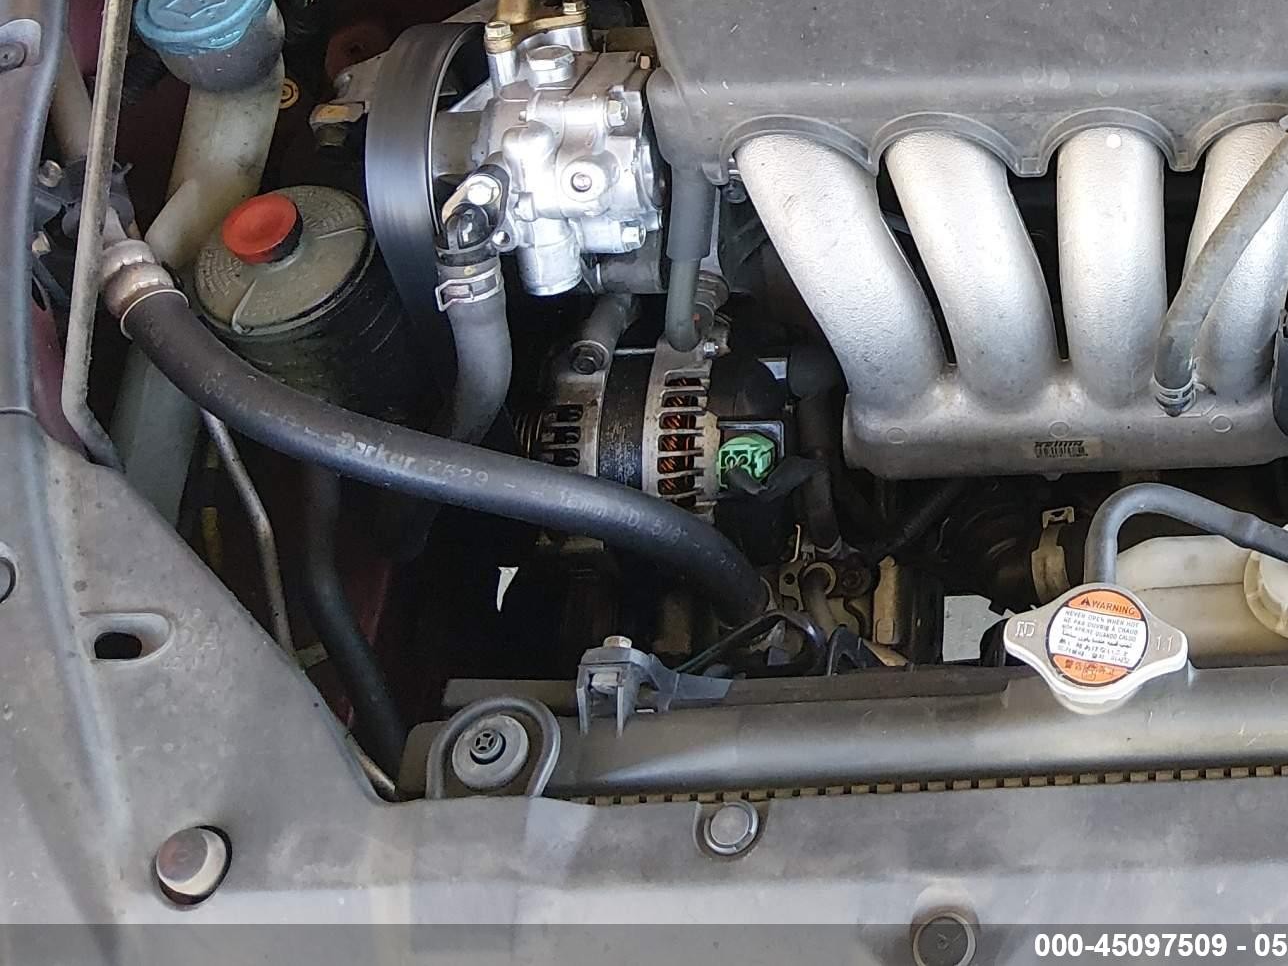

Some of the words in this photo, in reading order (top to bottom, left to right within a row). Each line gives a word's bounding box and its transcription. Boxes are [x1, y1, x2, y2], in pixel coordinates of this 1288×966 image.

[1092, 599, 1136, 616] WARNING
[1065, 610, 1086, 619] NEVER
[1088, 614, 1105, 623] OPEN
[1107, 617, 1124, 626] WHEN
